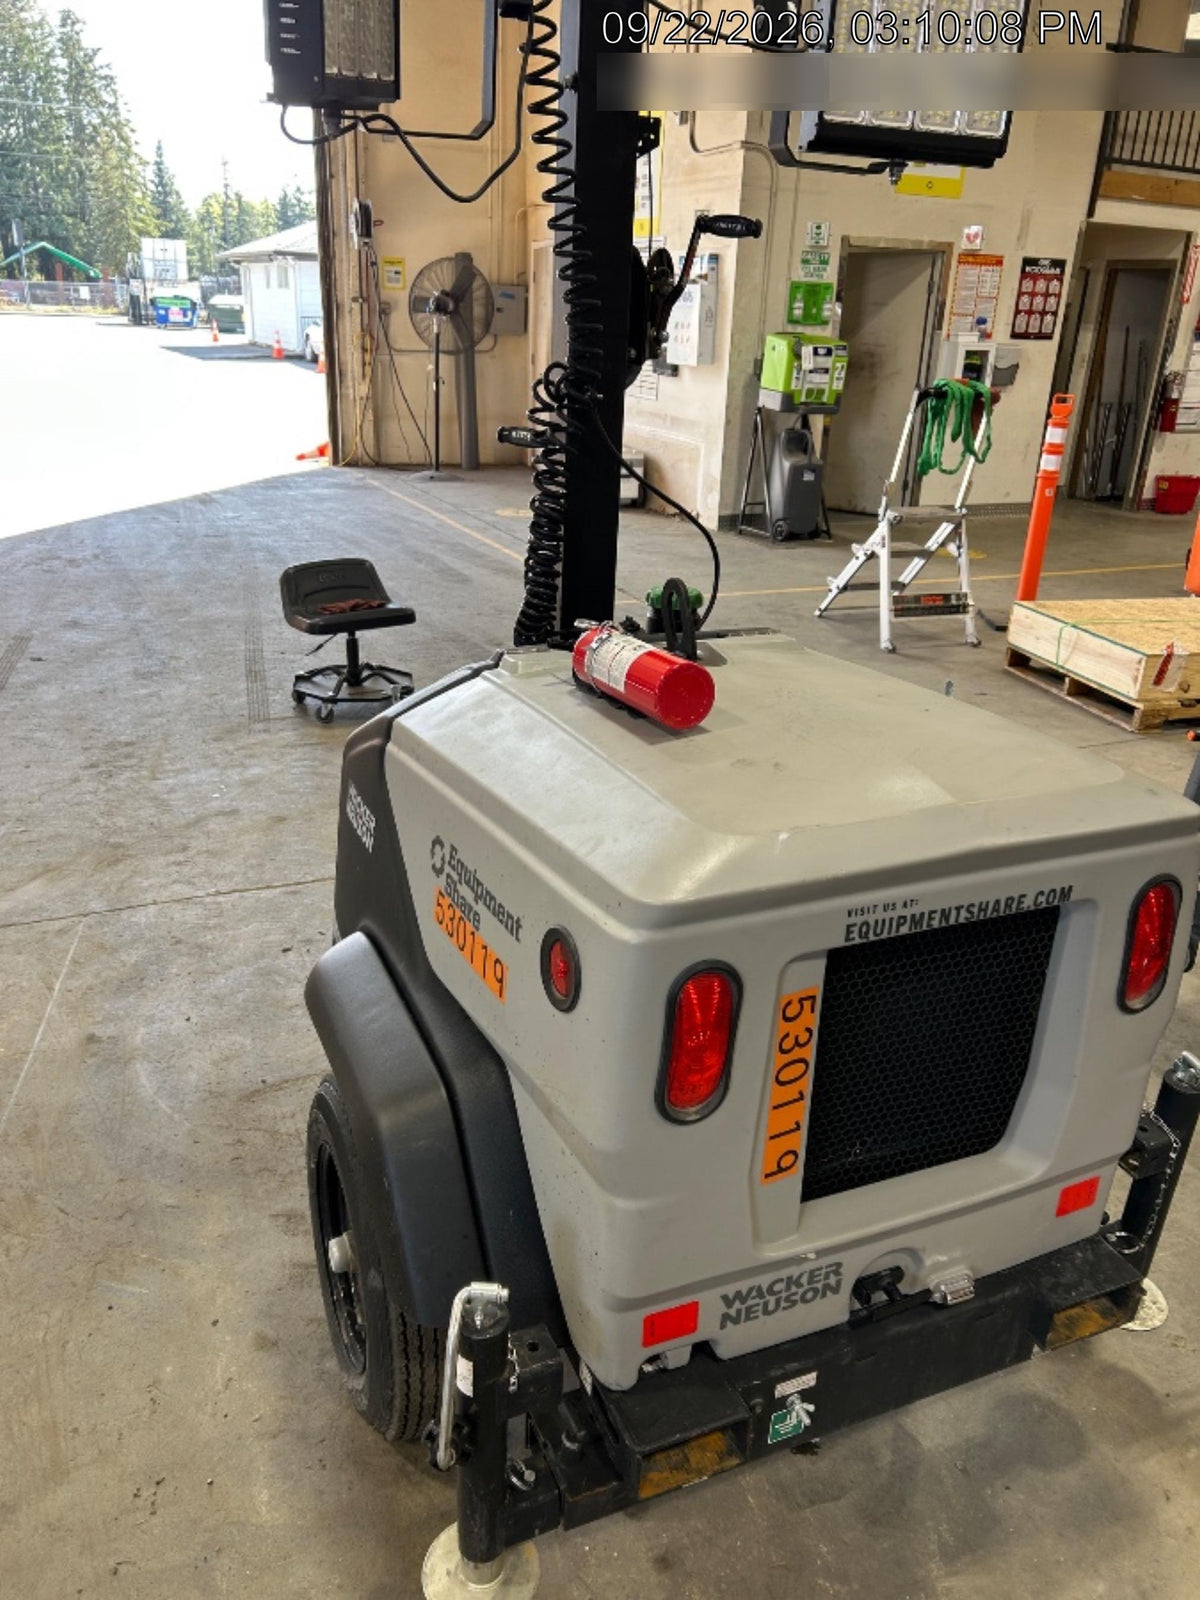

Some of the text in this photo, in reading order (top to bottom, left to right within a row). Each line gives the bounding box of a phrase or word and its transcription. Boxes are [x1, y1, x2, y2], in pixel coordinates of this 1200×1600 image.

[444, 872, 481, 933] Share
[447, 843, 523, 944] Equipment
[843, 884, 1074, 943] EQUIPMENTSHARE.COM
[847, 898, 920, 918] VISIT US AT:
[435, 889, 505, 999] 530119
[763, 994, 818, 1180] 530119
[719, 1278, 843, 1331] NEUSON
[720, 1261, 843, 1310] WACKER
